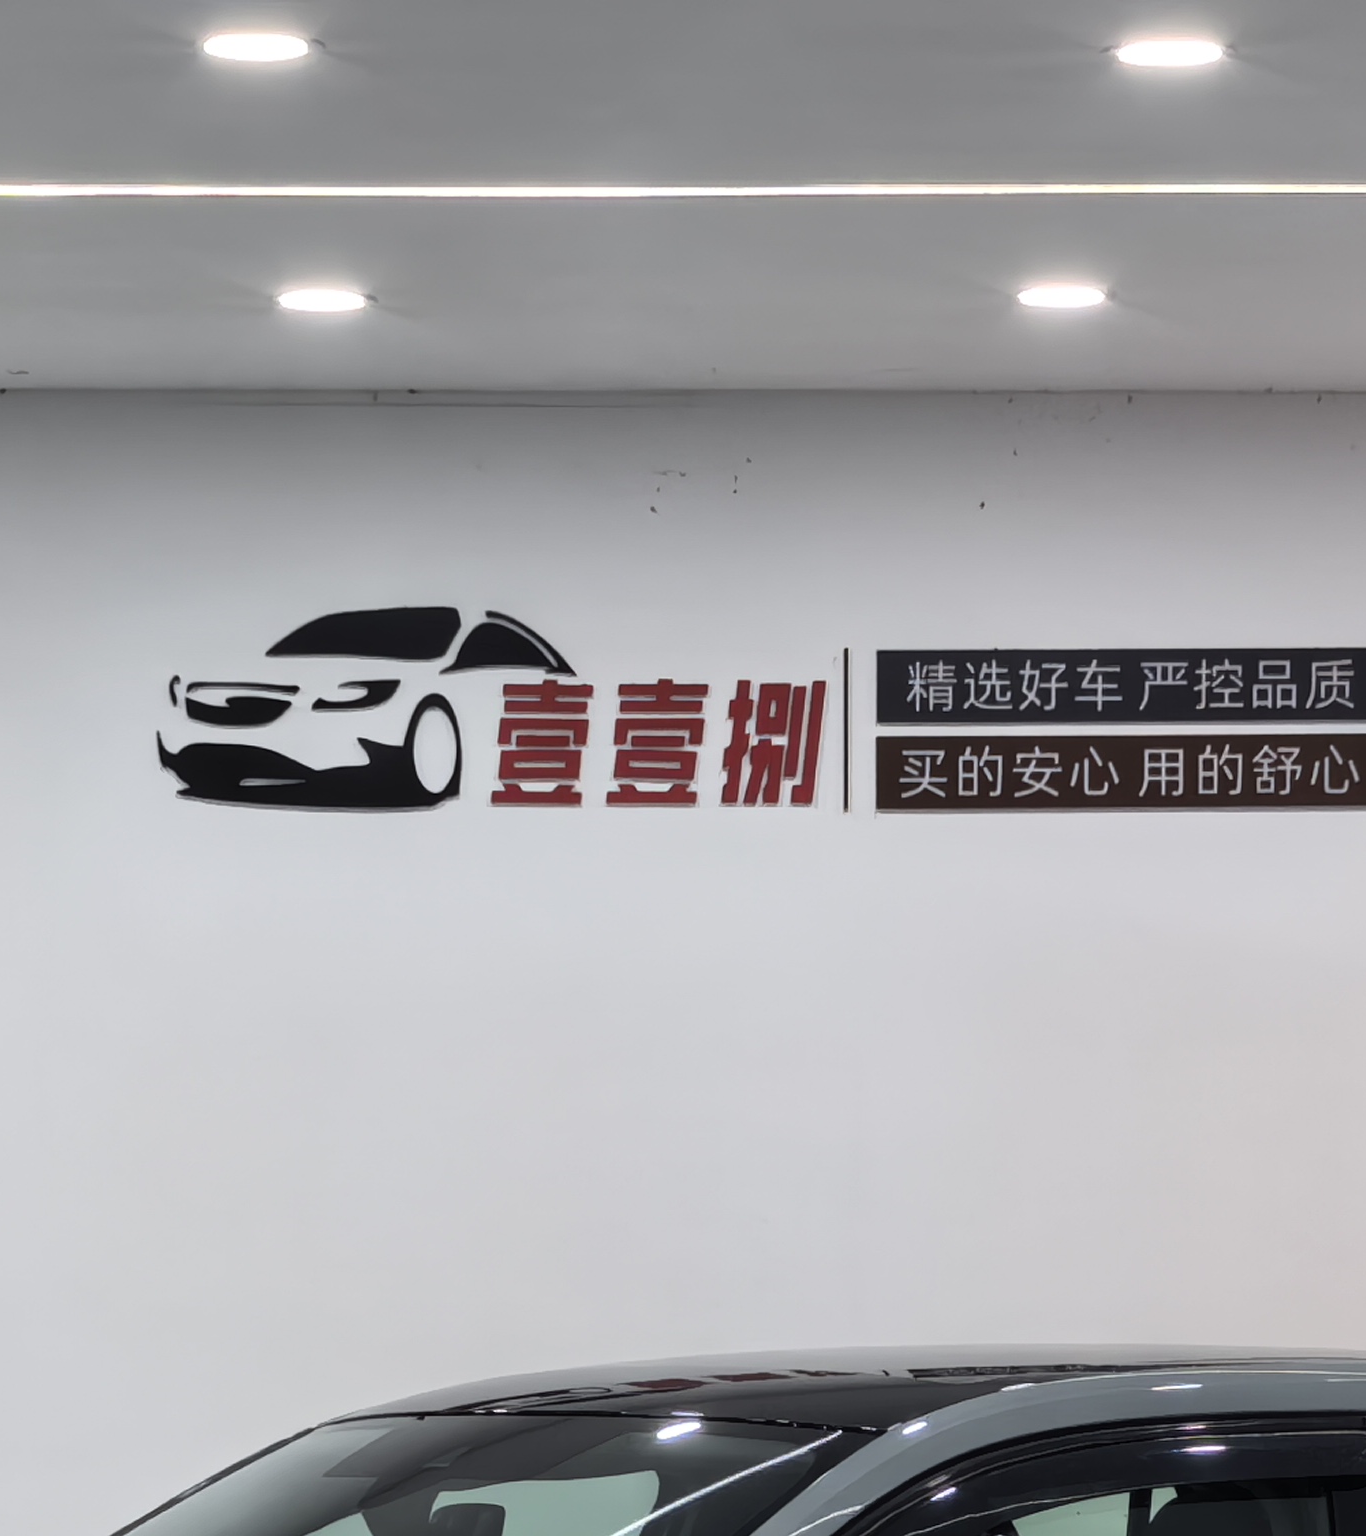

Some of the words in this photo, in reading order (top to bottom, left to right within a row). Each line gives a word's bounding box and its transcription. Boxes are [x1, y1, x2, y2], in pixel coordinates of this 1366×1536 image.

[905, 658, 1123, 712] 精选好车
[1138, 657, 1355, 712] 严控品质
[490, 678, 828, 806] 壹壹捌
[898, 744, 1121, 799] 买的安心
[1138, 743, 1361, 798] 用的舒心
